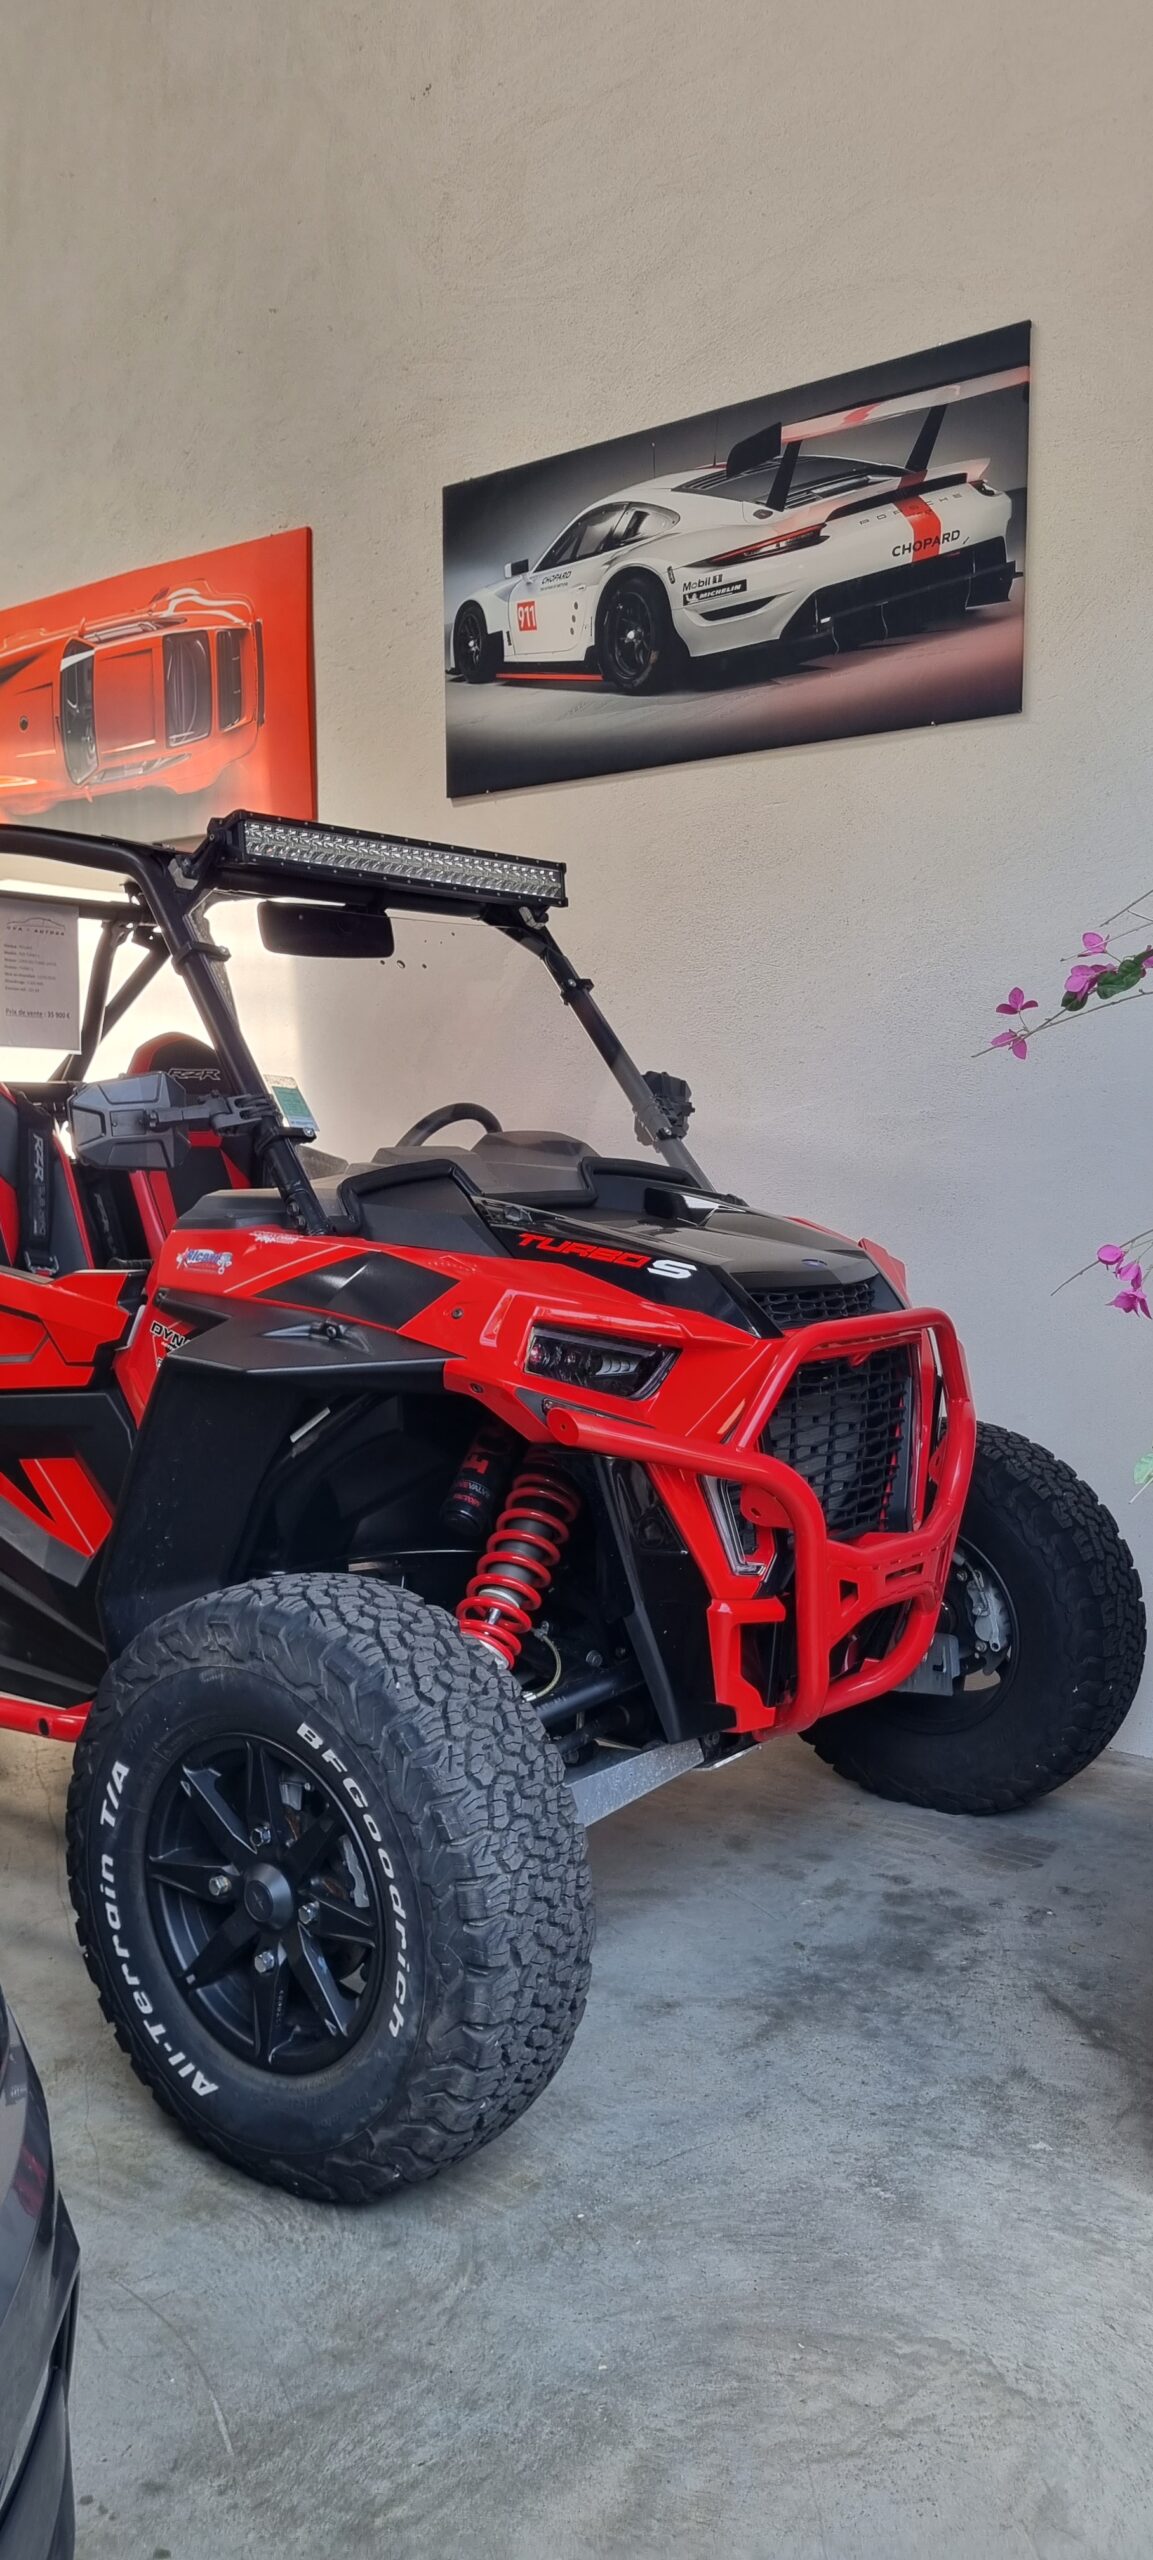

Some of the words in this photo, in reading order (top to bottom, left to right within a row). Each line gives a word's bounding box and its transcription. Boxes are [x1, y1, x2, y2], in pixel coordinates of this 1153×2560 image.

[892, 530, 960, 557] CHOPARD
[683, 577, 711, 592] Mobil
[699, 584, 742, 599] MICHELIN
[518, 605, 537, 629] 911
[5, 1008, 17, 1017] Prix
[26, 1010, 43, 1018] vente
[168, 1068, 221, 1081] RZR
[33, 1133, 44, 1182] RZR
[518, 1232, 651, 1269] TURBO
[647, 1259, 697, 1279] S
[100, 1760, 130, 1829] T/A
[297, 1723, 411, 2039] BFGoodrich
[99, 1854, 219, 2096] All-Terrain
